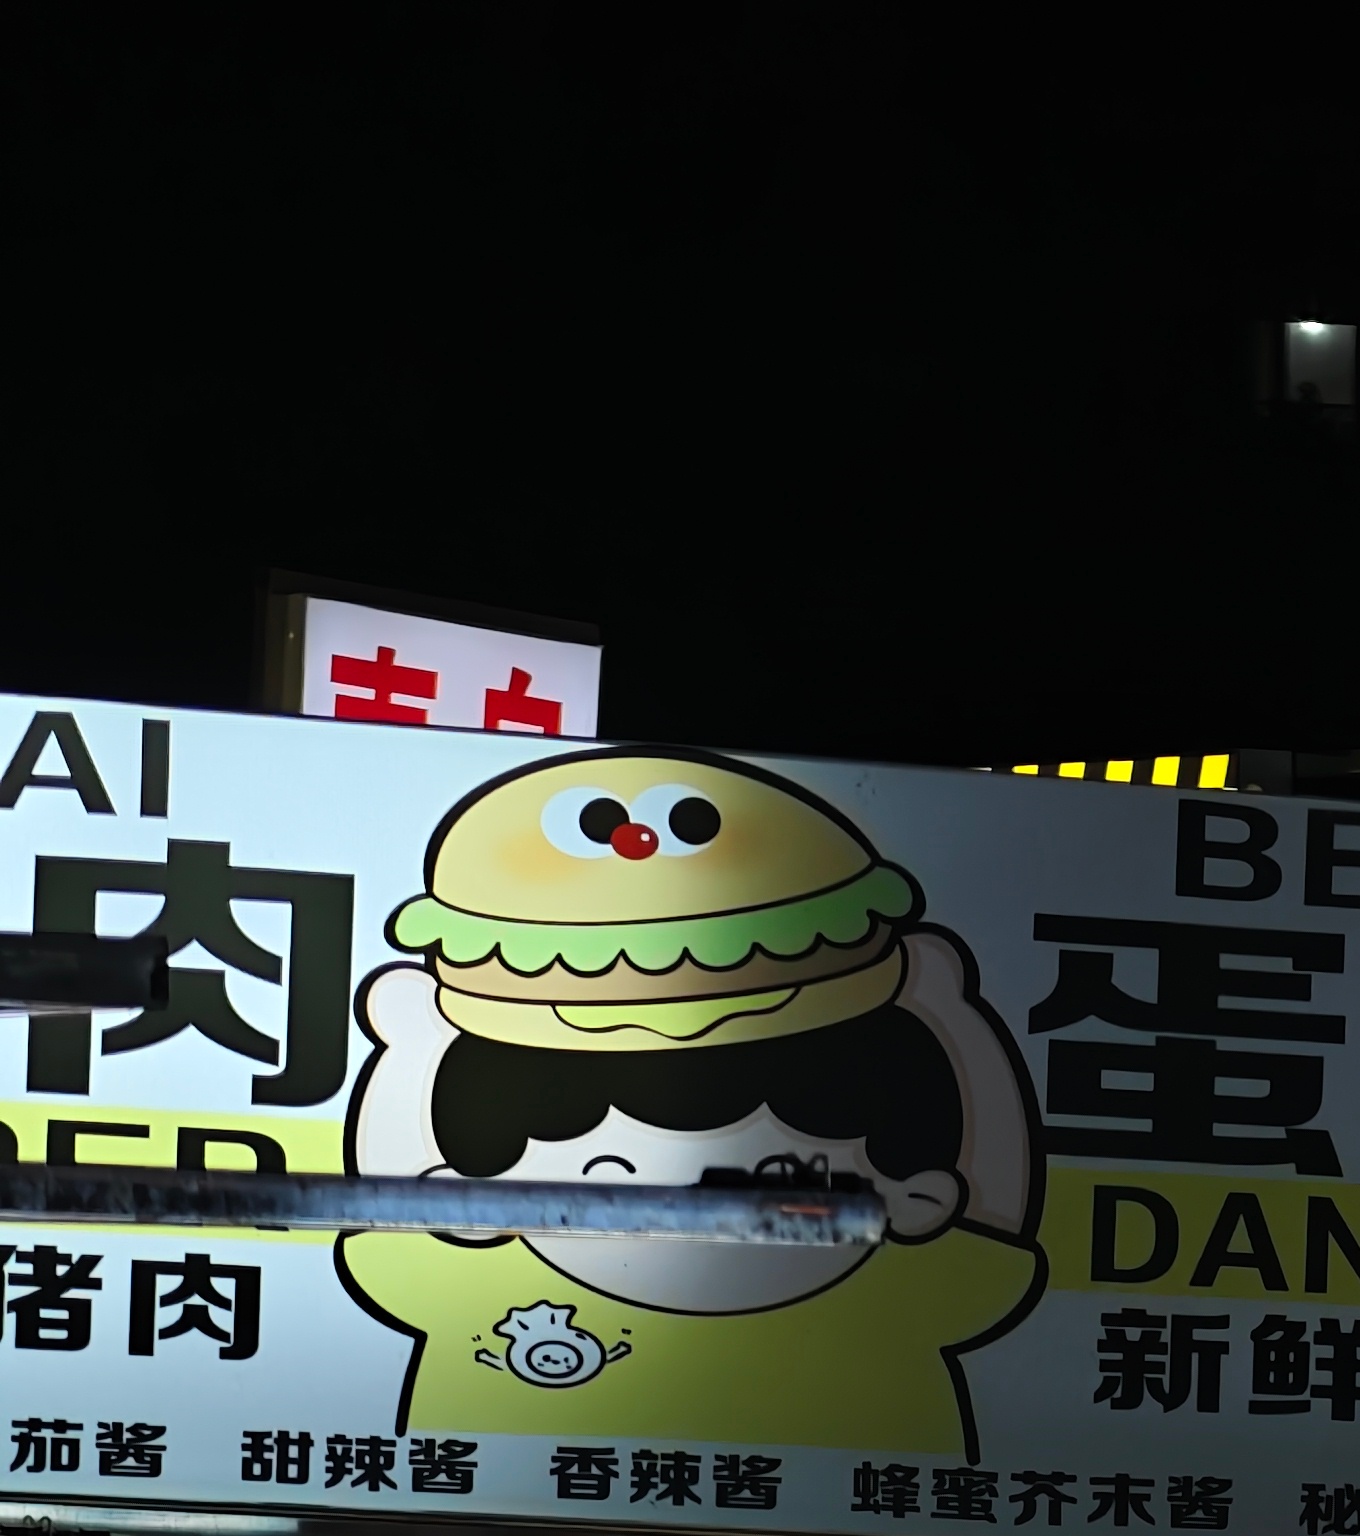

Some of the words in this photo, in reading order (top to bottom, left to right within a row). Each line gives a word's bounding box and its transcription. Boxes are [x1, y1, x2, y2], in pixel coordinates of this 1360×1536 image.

[0, 711, 171, 819] AI
[27, 838, 355, 1106] 肉
[0, 1244, 262, 1360] 猪肉
[10, 1418, 168, 1478] 茄酱
[241, 1429, 479, 1495] 甜辣酱
[550, 1446, 783, 1510] 香辣酱
[852, 1461, 1233, 1530] 蜂蜜芥末酱
